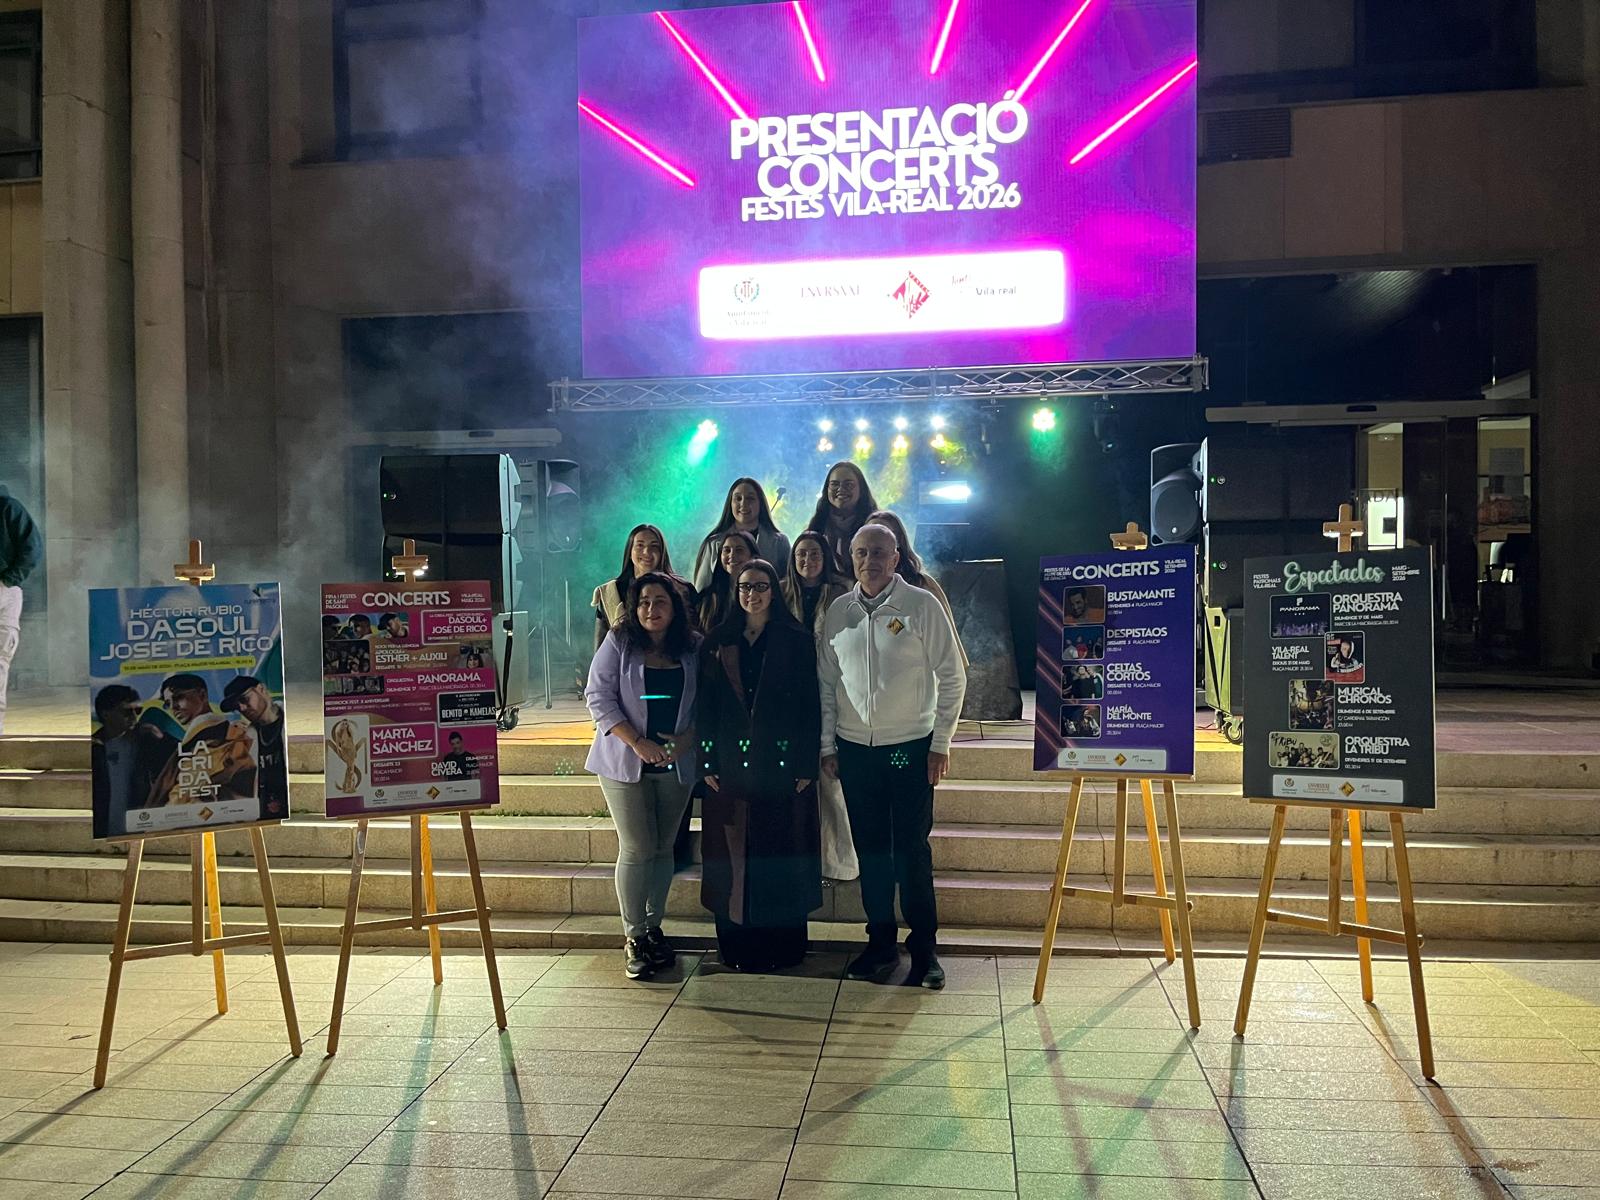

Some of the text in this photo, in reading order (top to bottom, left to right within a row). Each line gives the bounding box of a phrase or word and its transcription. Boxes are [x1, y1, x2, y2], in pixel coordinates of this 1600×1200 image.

[730, 89, 1028, 160] PRESENTACIÓ
[757, 142, 1000, 198] CONCERTS
[741, 182, 1022, 222] FESTES VILA-REAL 2026
[1072, 560, 1160, 580] CONCERTS
[1283, 557, 1386, 593] Espectacles
[361, 591, 451, 607] CONCERTS
[1107, 588, 1176, 602] BUSTAMANTE
[1332, 592, 1403, 604] ORQUESTRA
[130, 603, 243, 619] HÉCTOR RUBIO
[1332, 601, 1400, 614] PANORAMA
[126, 615, 260, 641] DASOUL
[453, 625, 465, 633] DE
[466, 624, 488, 632] RICO
[1106, 626, 1168, 638] DESPISTAOS
[100, 634, 274, 661] JOSÉ DE RICO
[1271, 645, 1310, 654] VILA-REAL
[376, 654, 410, 663] ESTHER
[418, 652, 448, 662] AUXILI
[1106, 662, 1142, 673] CELTAS
[417, 672, 481, 684] PANORAMA
[1106, 670, 1151, 681] CORTOS
[1337, 686, 1383, 696] MUSICAL
[1337, 694, 1393, 704] CHRONOS
[442, 706, 496, 718] BENITO KAMELAS
[1106, 704, 1133, 714] MARÍA
[1106, 712, 1152, 720] DEL MONTE
[372, 727, 416, 741] MARTA
[372, 740, 434, 755] SÁNCHEZ
[1344, 736, 1410, 747] ORQUESTRA
[177, 740, 210, 757] LA
[1344, 744, 1389, 755] LA TRIBU
[177, 755, 213, 772] CRI
[431, 760, 457, 770] DAVID
[178, 770, 212, 786] DA
[431, 768, 463, 776] CIVERA
[178, 784, 222, 799] FEST
